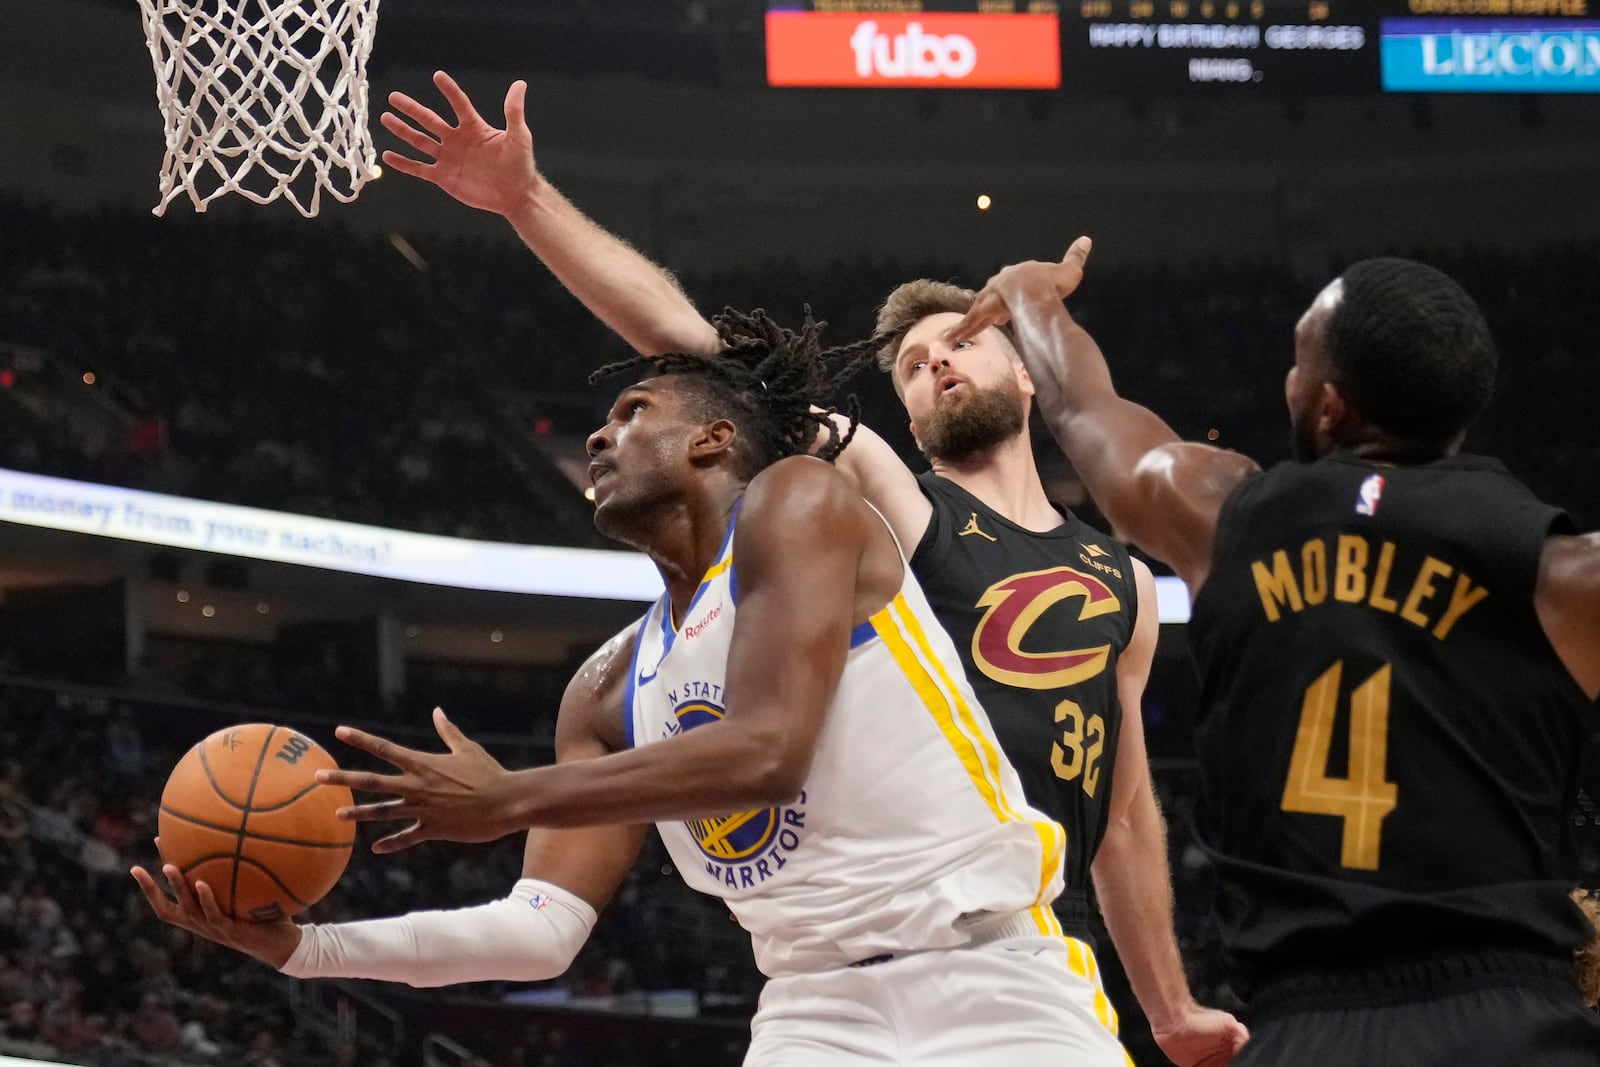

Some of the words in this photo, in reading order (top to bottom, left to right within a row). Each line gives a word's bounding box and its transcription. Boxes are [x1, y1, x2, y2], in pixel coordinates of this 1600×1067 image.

[851, 20, 976, 78] fubo
[1089, 23, 1157, 48] HAPPY
[1265, 25, 1365, 50] GEORGES
[11, 491, 112, 529] money
[124, 501, 193, 535] from
[204, 519, 269, 548] your
[1079, 553, 1122, 579] CLIFFS
[1251, 534, 1489, 641] MOBLEY
[1050, 699, 1105, 799] 32
[1281, 659, 1398, 871] 4
